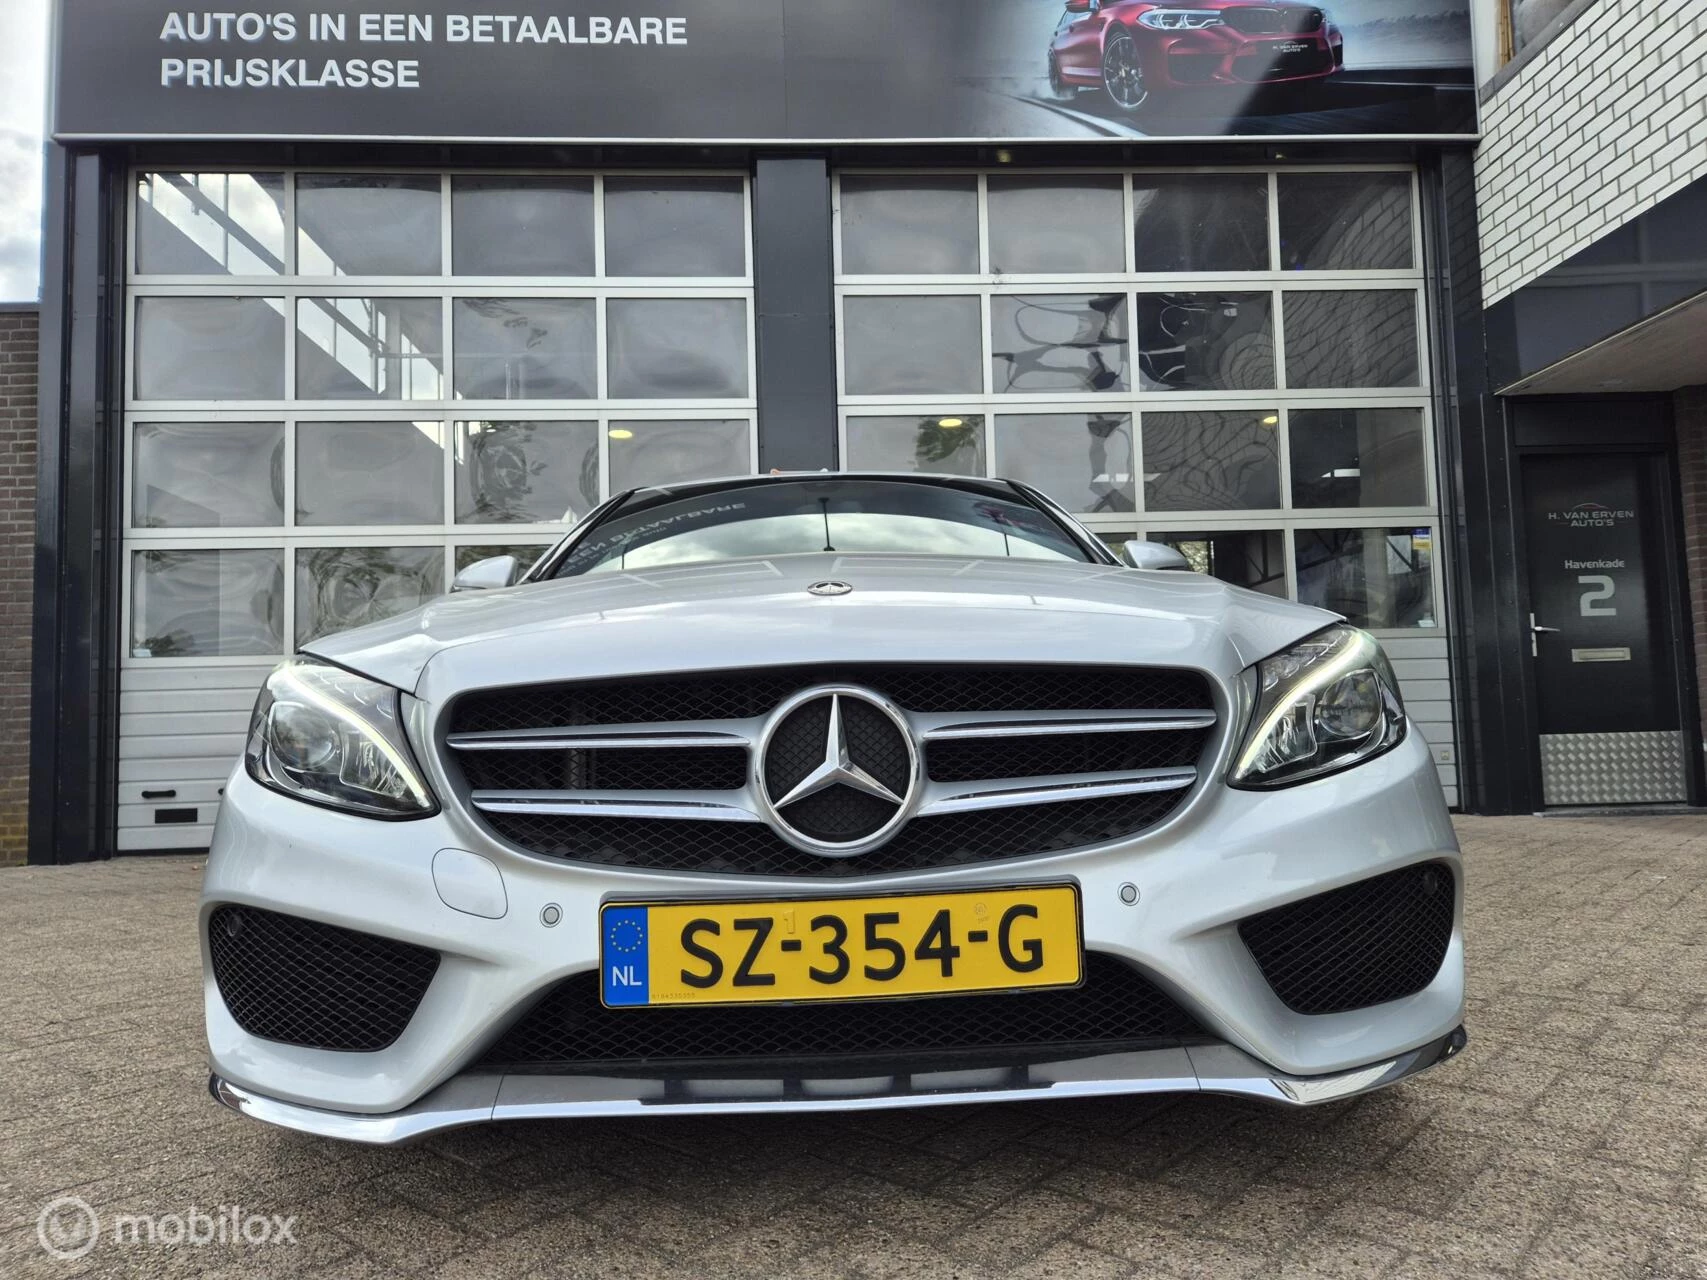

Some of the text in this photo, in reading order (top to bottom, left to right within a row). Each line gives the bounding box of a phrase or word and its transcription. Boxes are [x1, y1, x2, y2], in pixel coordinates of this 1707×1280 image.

[159, 11, 688, 45] AUTO'S IN EEN BETAALBARE
[160, 58, 420, 88] PRIJSKLASSE
[1548, 510, 1635, 520] H. VAN ERVEN
[1570, 518, 1615, 527] AUTO'S
[1564, 559, 1625, 570] Havenkade
[1577, 575, 1617, 617] 2
[680, 903, 1044, 989] SZ-354-G
[612, 966, 643, 987] NL
